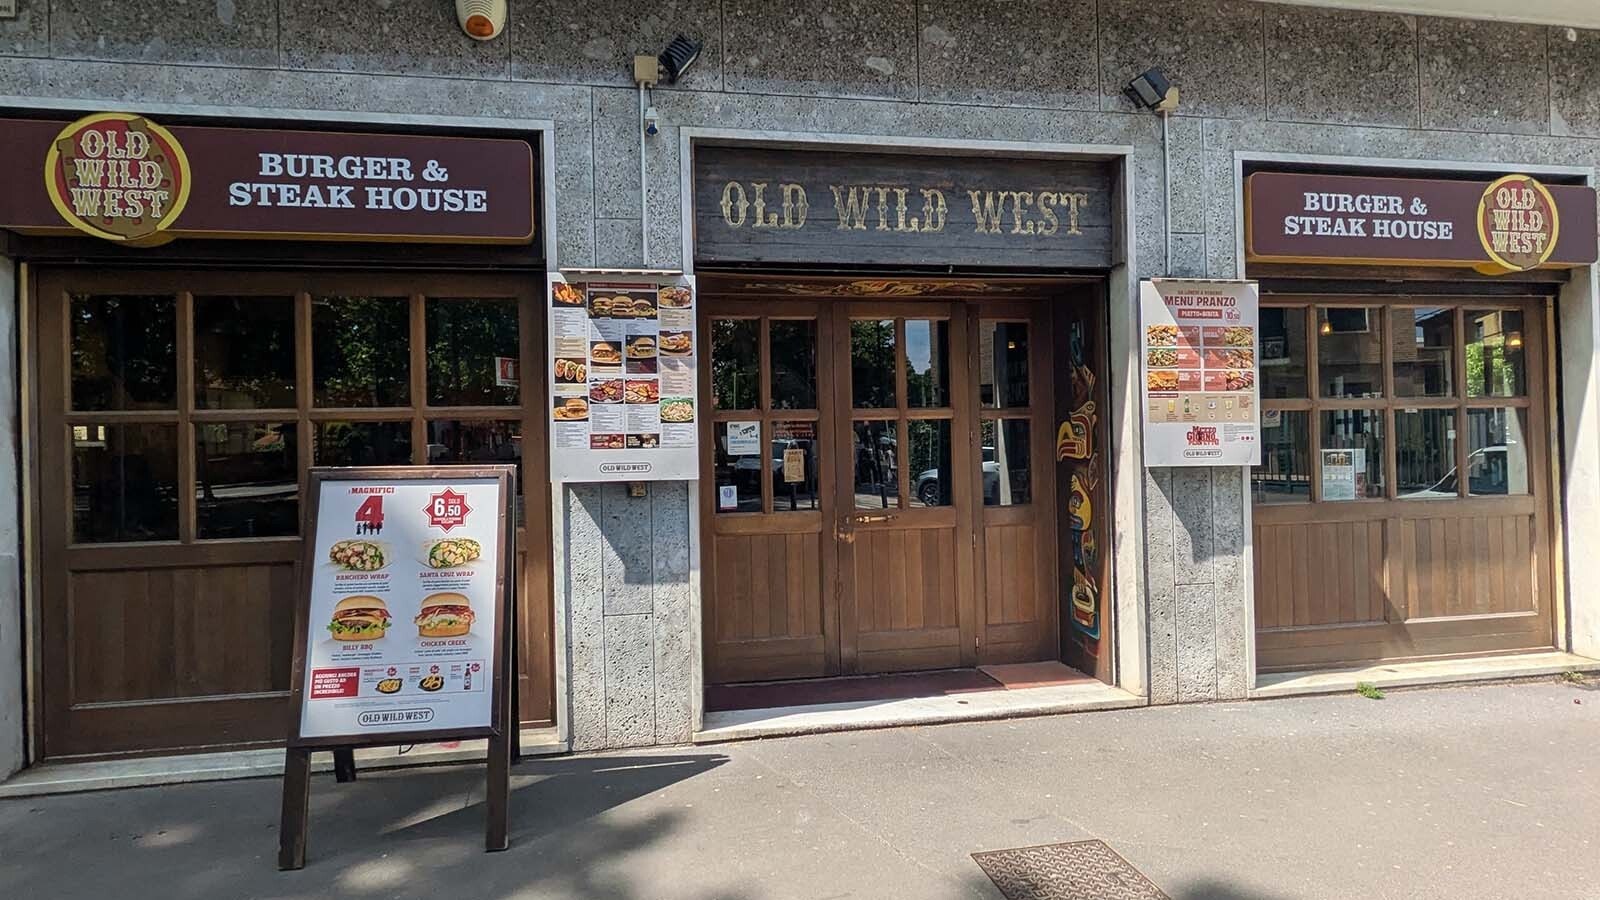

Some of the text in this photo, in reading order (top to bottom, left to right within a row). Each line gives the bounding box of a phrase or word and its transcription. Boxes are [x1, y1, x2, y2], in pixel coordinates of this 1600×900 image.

[80, 129, 150, 159] OLD
[74, 159, 164, 189] WILD
[258, 153, 449, 182] BURGER &
[70, 188, 169, 218] WEST
[229, 183, 487, 212] STEAK HOUSE
[720, 181, 1088, 235] OLD WILD WEST
[1303, 192, 1428, 215] BURGER &
[1496, 187, 1536, 209] OLD
[1284, 215, 1453, 240] STEAK HOUSE
[1493, 209, 1543, 232] WILD
[1491, 231, 1546, 254] WEST
[1164, 295, 1236, 307] MENU PRANZO
[1186, 432, 1216, 441] GIORNO
[355, 495, 385, 528] 4
[434, 498, 461, 517] 6,50
[360, 643, 374, 651] BBQ
[362, 710, 431, 723] OLD WILD WEST
